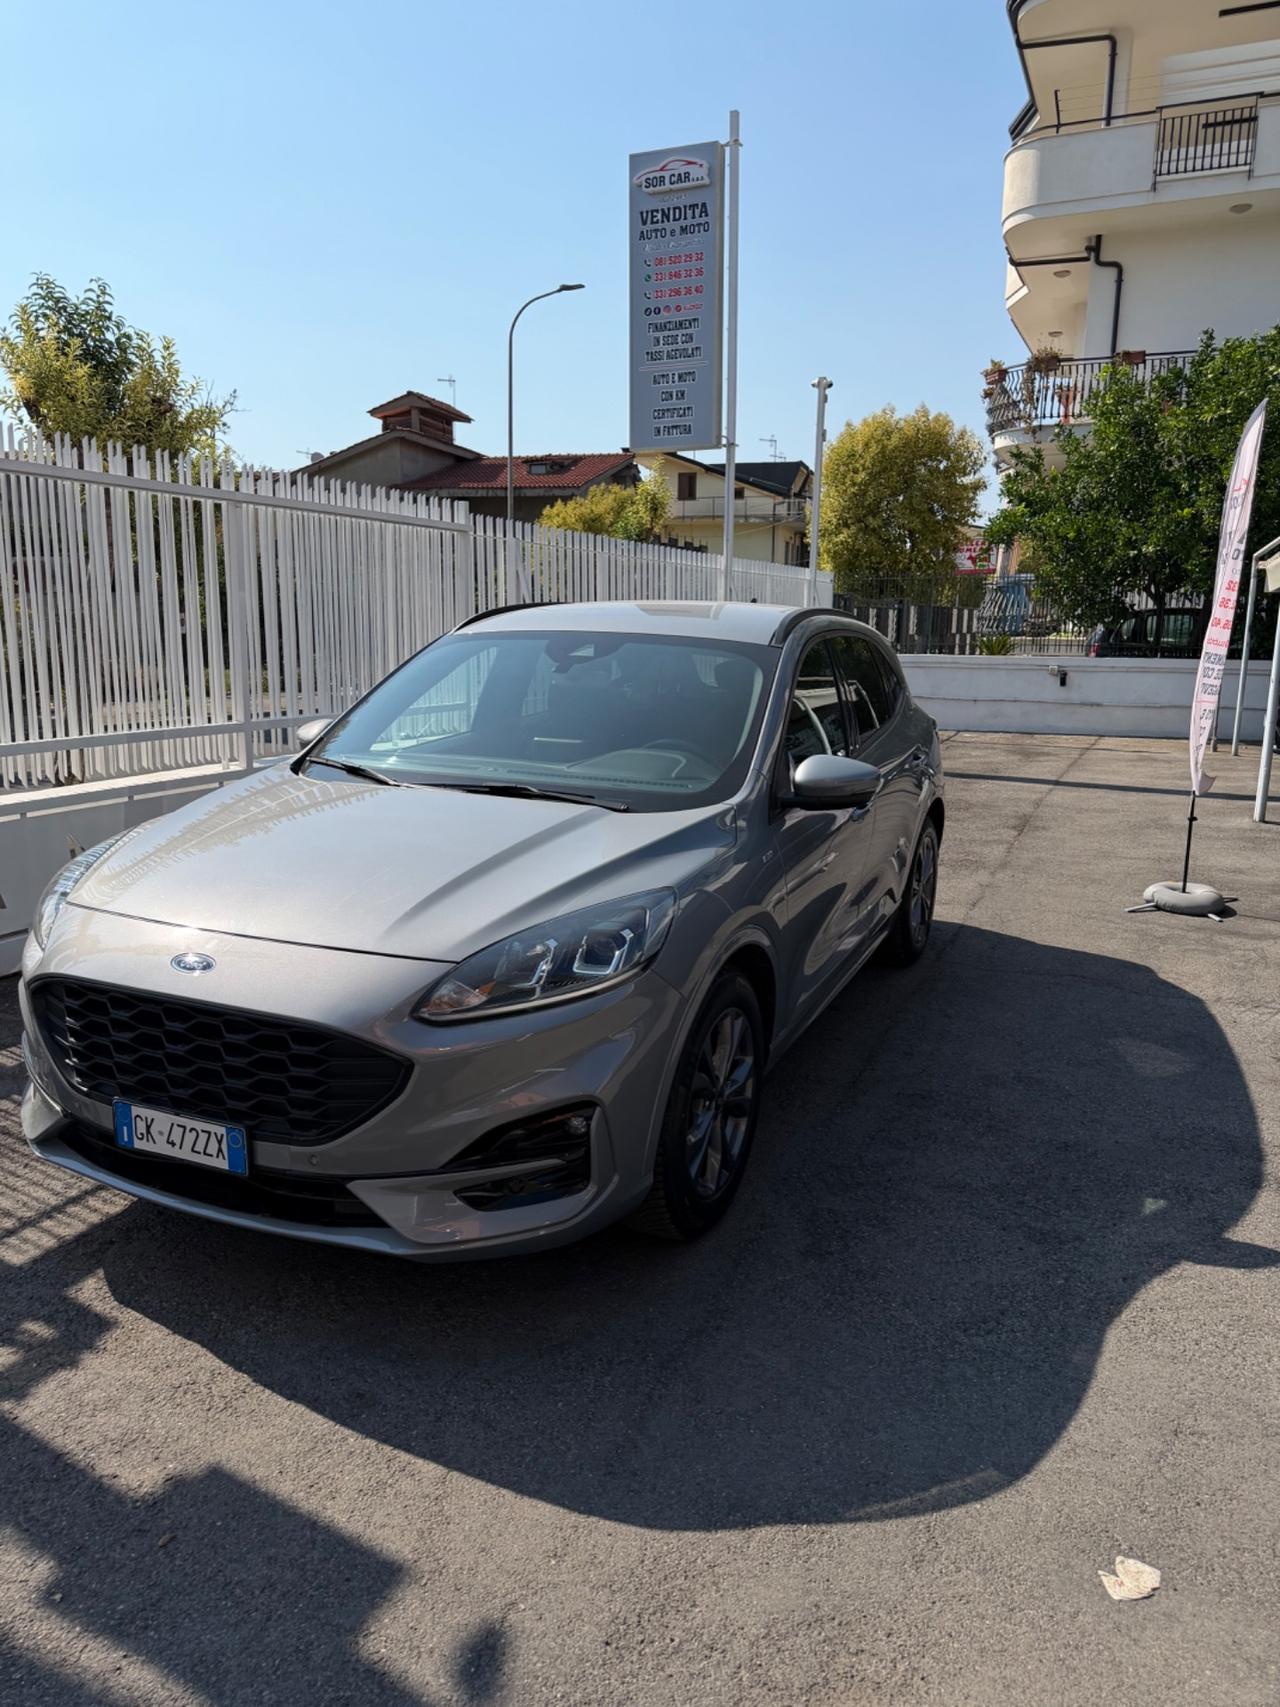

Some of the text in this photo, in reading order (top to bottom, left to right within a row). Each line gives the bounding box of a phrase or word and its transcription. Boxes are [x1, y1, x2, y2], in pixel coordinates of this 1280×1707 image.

[644, 175, 666, 189] SOR
[640, 203, 709, 226] VENDITA
[638, 221, 710, 241] AUTO e MOTO
[647, 318, 700, 333] FINANZIAMENTI
[653, 333, 694, 347] IN SEDE CON
[645, 347, 702, 362] TASSI AGEVOLATI
[652, 371, 696, 385] AUTO E MOTO
[661, 390, 686, 402] CON KM
[652, 406, 693, 420] CERTIFICATI
[653, 424, 692, 437] IN FATTURA
